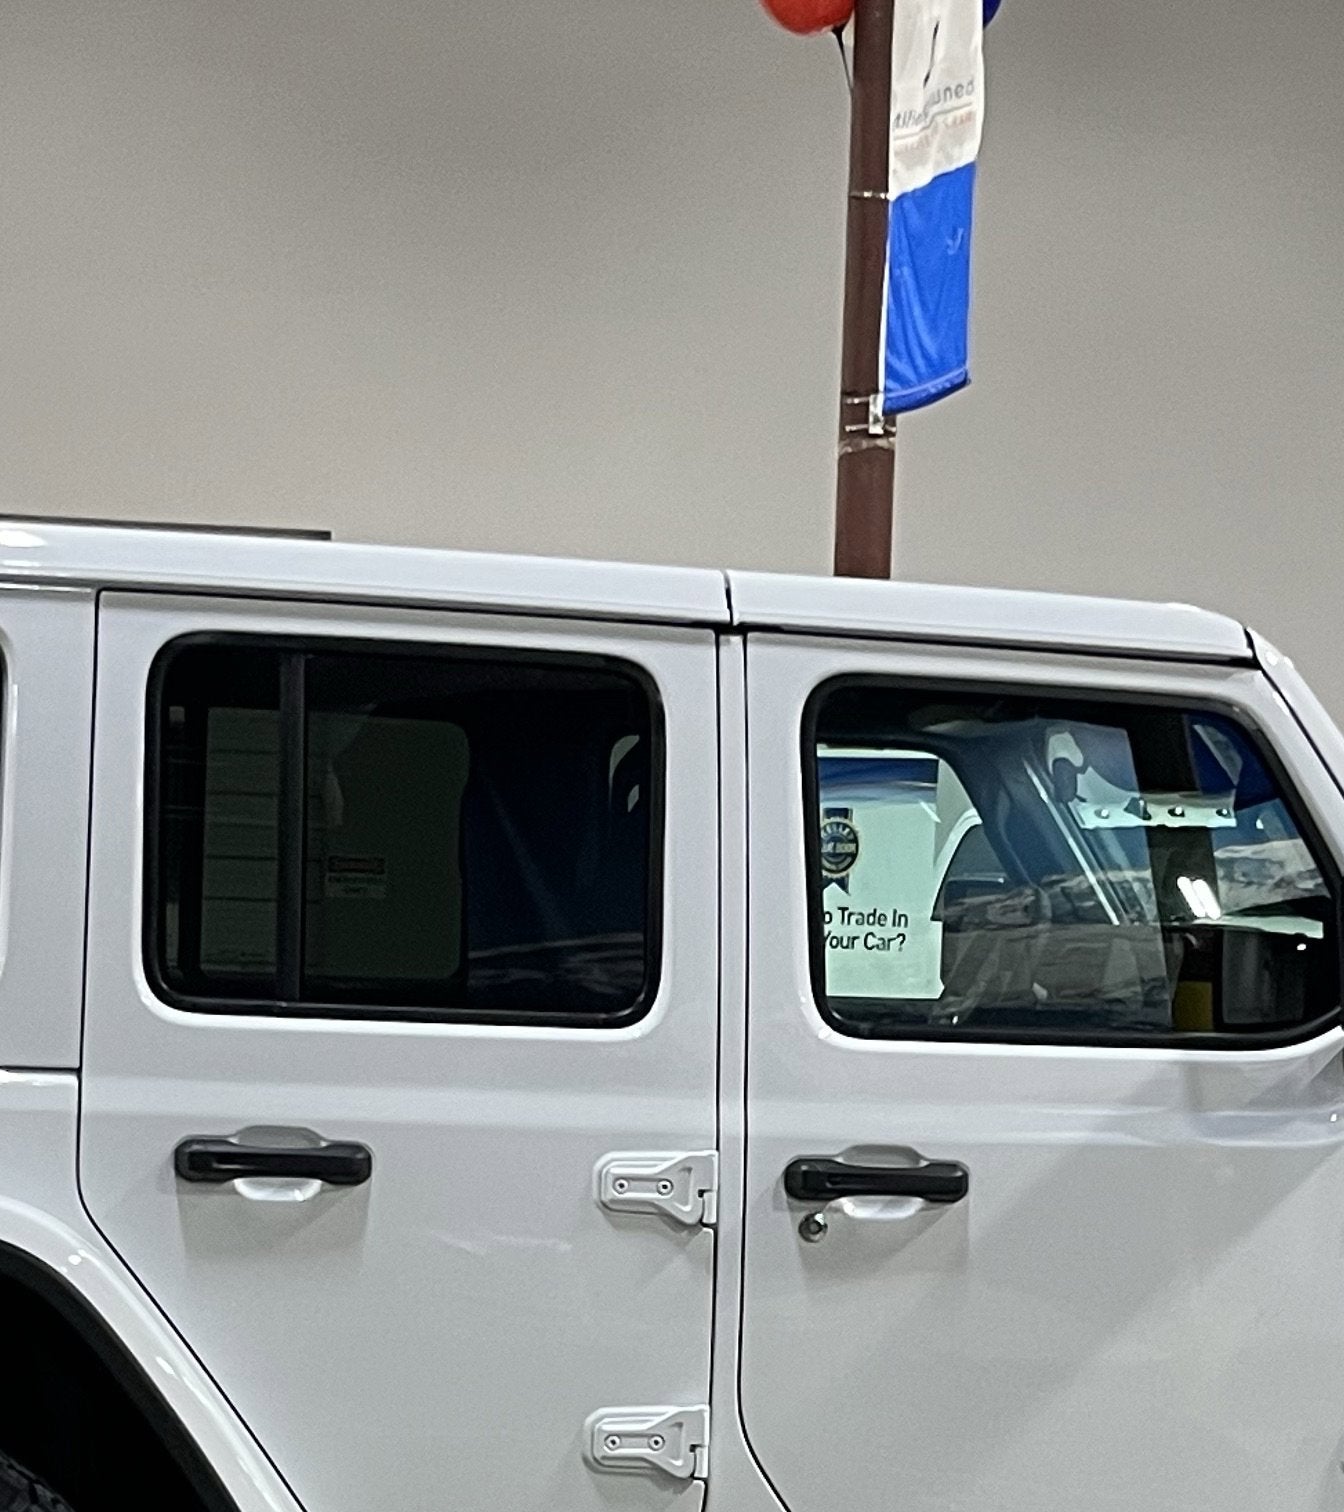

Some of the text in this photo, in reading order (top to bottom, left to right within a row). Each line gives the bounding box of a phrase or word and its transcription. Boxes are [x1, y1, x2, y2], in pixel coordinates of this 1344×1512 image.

[837, 906, 888, 927] Trade
[892, 908, 909, 928] In
[863, 931, 907, 952] Car?
